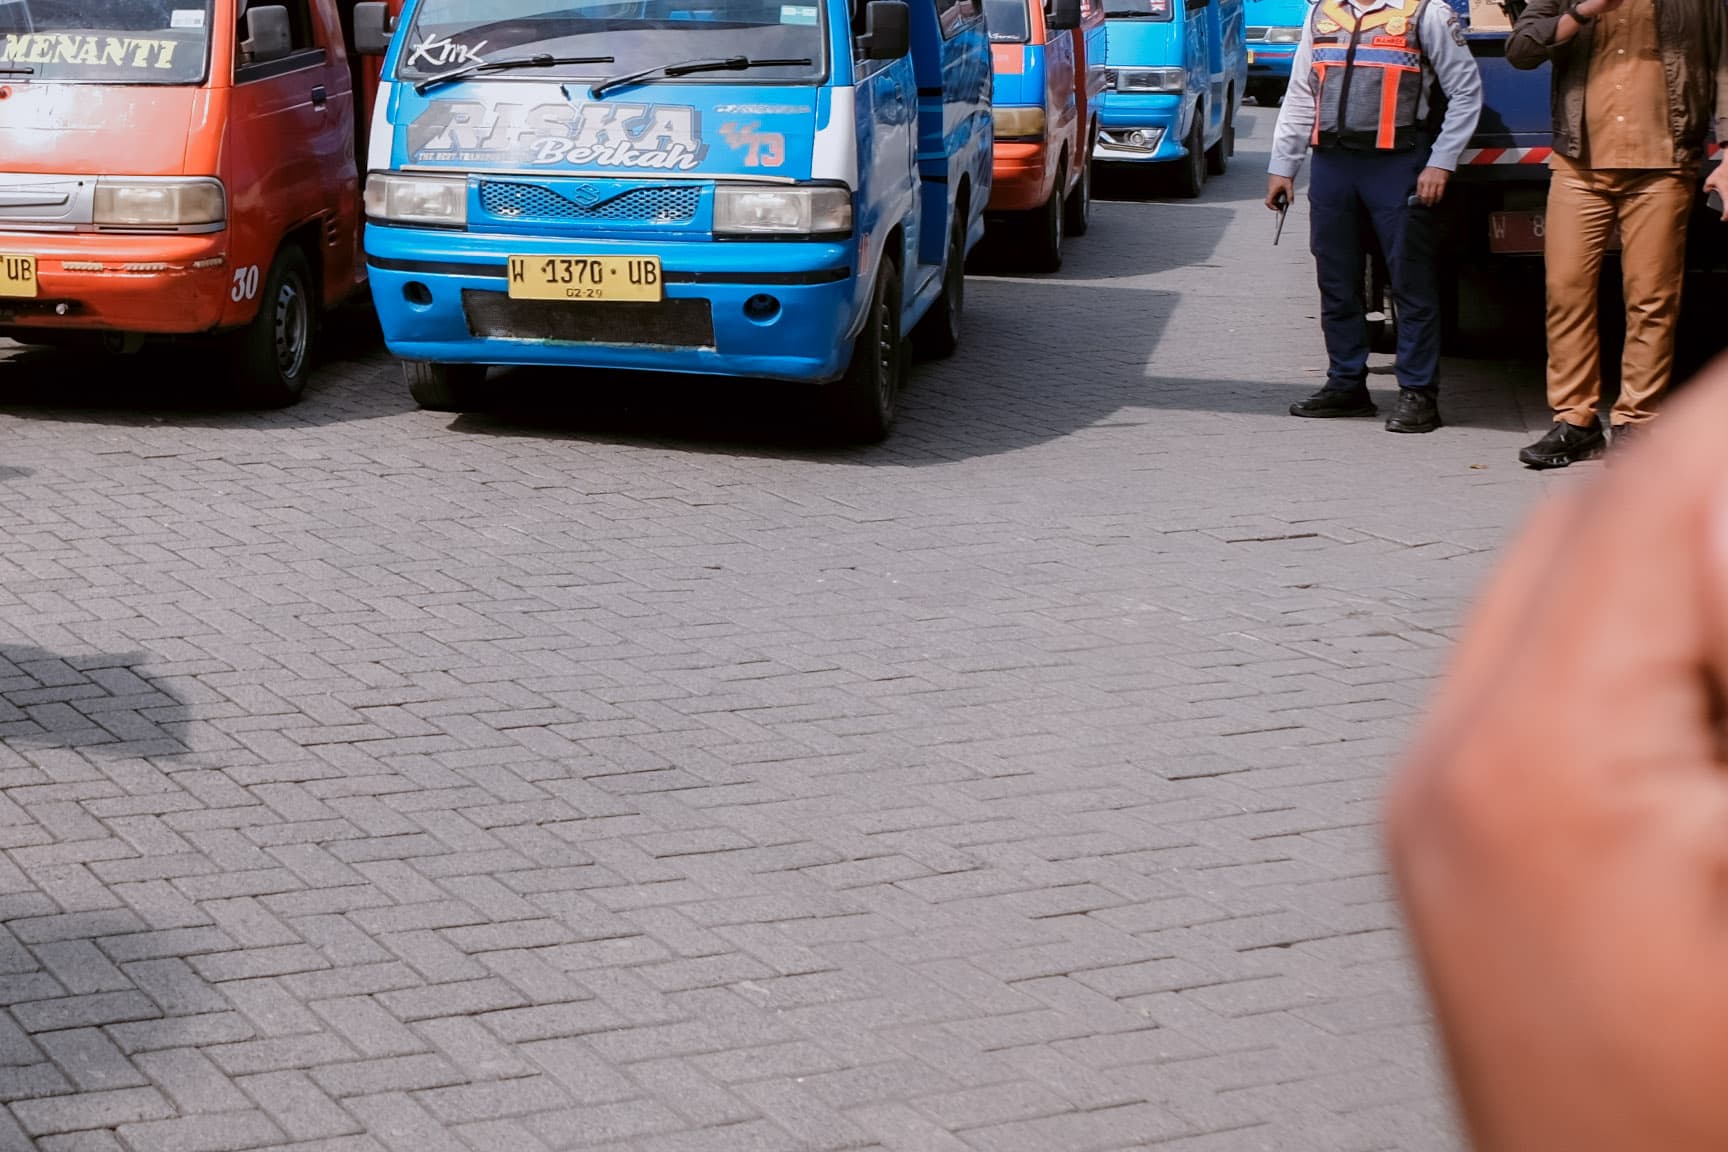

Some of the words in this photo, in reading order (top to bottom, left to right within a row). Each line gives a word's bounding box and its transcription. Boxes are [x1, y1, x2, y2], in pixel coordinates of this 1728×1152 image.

[0, 33, 178, 69] MENANTI
[420, 101, 700, 152] RISKA
[530, 136, 700, 170] Berkah
[1491, 215, 1506, 240] W
[1532, 214, 1546, 238] 8
[6, 257, 32, 281] UB
[231, 264, 260, 302] 30
[511, 259, 525, 283] W
[544, 259, 603, 284] 1370
[627, 260, 658, 285] UB
